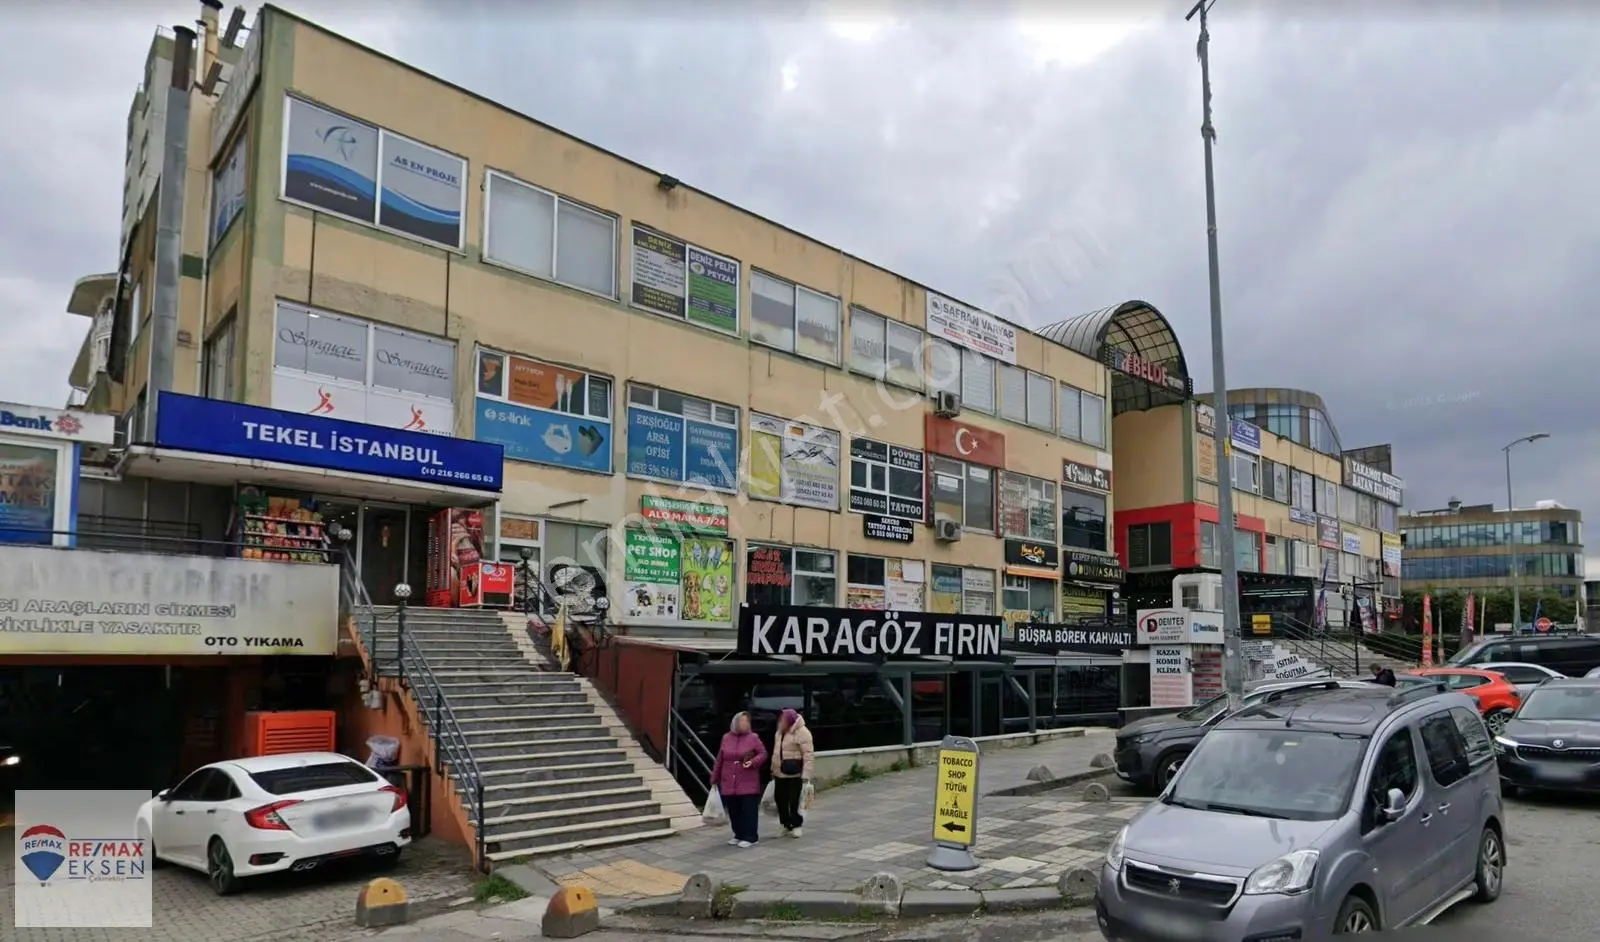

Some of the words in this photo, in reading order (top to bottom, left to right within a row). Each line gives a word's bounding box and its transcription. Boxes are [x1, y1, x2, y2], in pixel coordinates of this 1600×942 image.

[394, 155, 408, 169] AS
[411, 162, 424, 173] EN
[426, 166, 458, 184] PROJE
[707, 269, 736, 284] PEYZAJ
[943, 303, 979, 326] SAFRAN
[1133, 354, 1168, 387] BELDE
[242, 421, 324, 450] TEKEL
[331, 433, 444, 466] İSTANBUL
[646, 431, 670, 446] ARSA
[646, 444, 671, 460] OFİSİ
[648, 510, 669, 520] ALO
[890, 501, 922, 515] TATTOO
[867, 522, 886, 531] TATTOO
[628, 544, 646, 556] PET
[649, 547, 678, 559] SHOP
[1103, 567, 1122, 579] SAAT
[19, 600, 150, 617] ARAÇLARIN
[155, 603, 237, 619] GİRMESİ
[99, 621, 202, 636] YASAKTIR
[752, 611, 921, 655] KARAGÖZ
[935, 621, 1000, 656] FIRIN
[1018, 626, 1053, 646] BÜŞRA
[1055, 627, 1087, 645] BÖREK
[1089, 629, 1132, 645] KAHVALTI
[205, 636, 238, 648] OTO
[243, 636, 305, 648] YIKAMA
[1156, 657, 1182, 665] KOMBİ
[1276, 655, 1299, 669] ISITMA
[943, 756, 973, 767] TOBACCO
[948, 770, 967, 779] SHOP
[945, 782, 968, 793] TÜTÜN
[940, 808, 968, 819] NARGİLE
